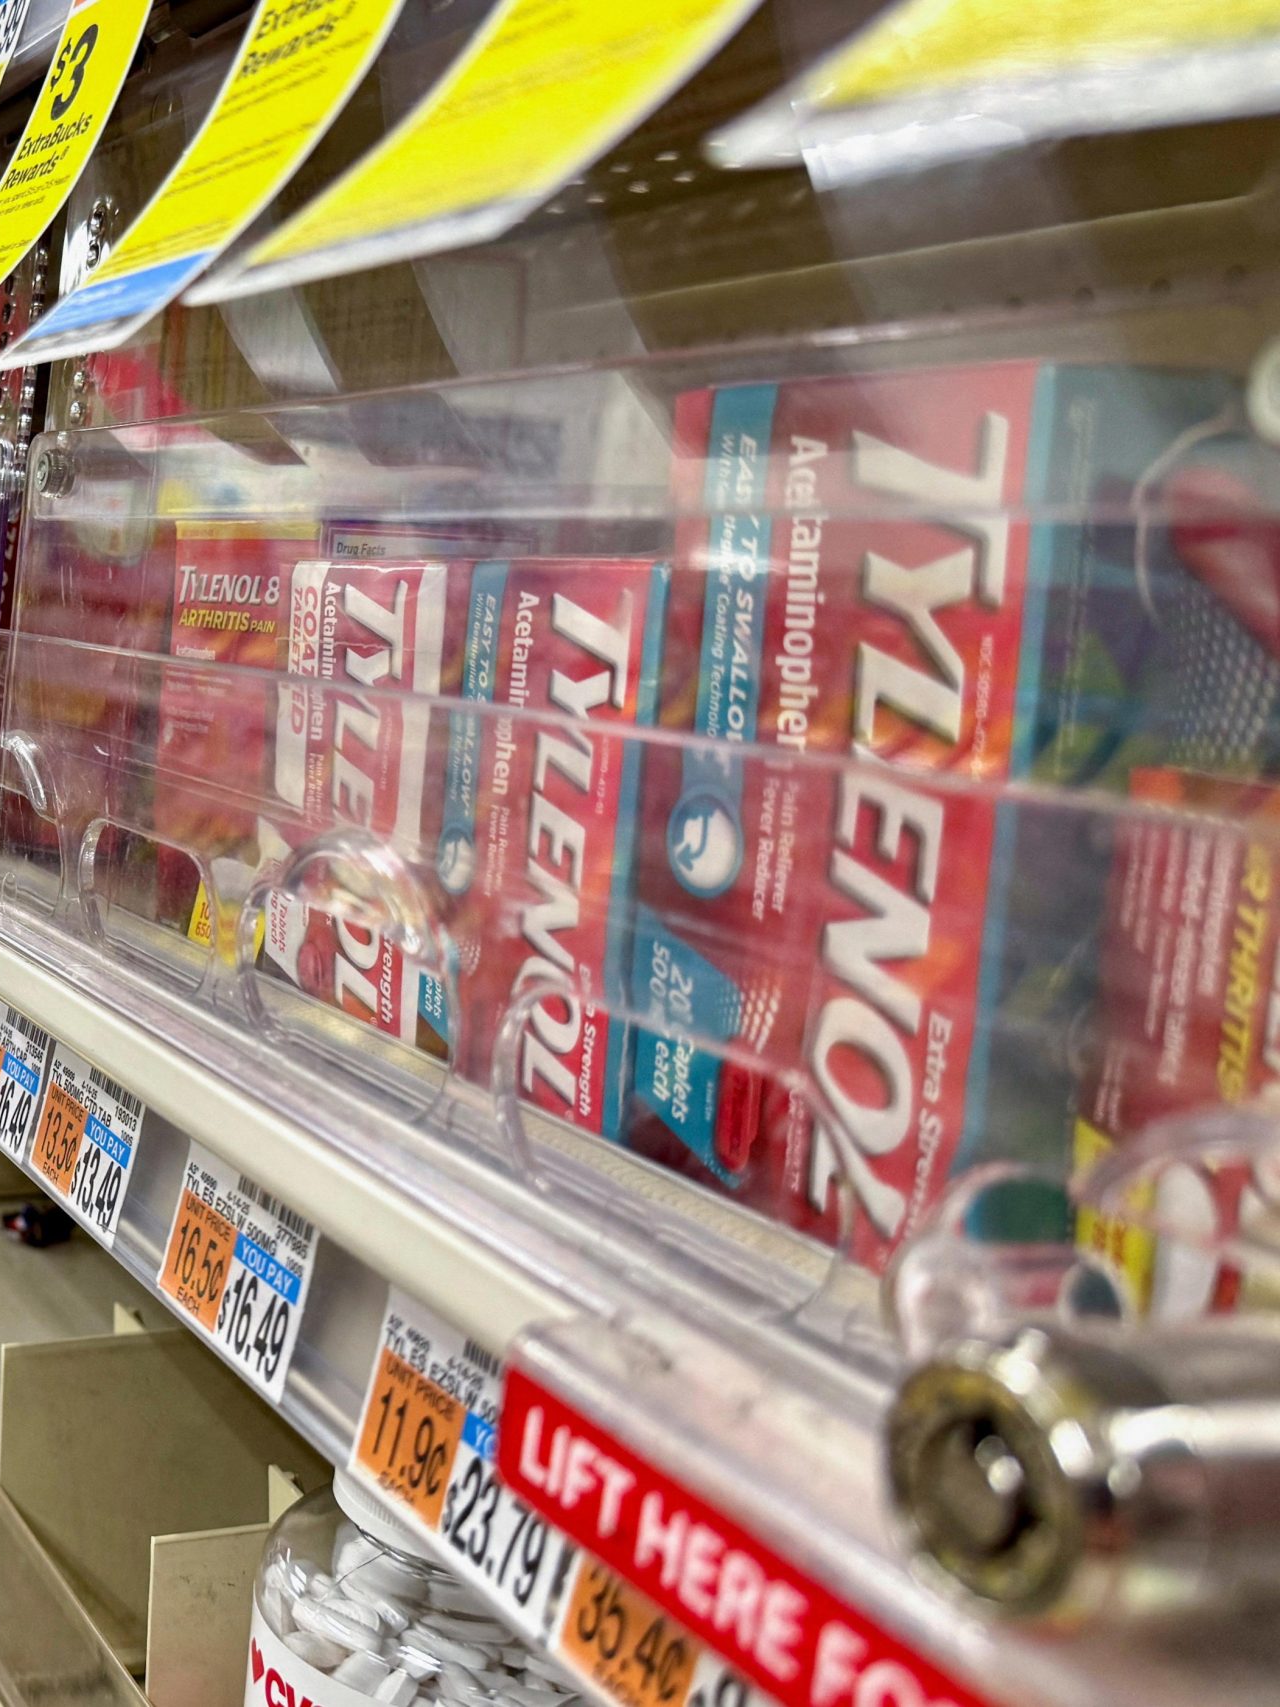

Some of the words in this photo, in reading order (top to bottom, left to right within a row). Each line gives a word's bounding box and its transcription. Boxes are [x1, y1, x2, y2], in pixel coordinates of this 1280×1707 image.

[51, 23, 99, 121] $3
[16, 112, 92, 161] ExtraBucks
[179, 566, 262, 604] TYLENOL
[264, 575, 281, 605] 8
[179, 609, 251, 632] ARTHRITIS
[250, 620, 276, 634] PAIN
[332, 579, 409, 1014] TYLEOL
[809, 411, 1009, 1239] TYLENOL
[515, 588, 633, 1107] TYLENOL
[378, 932, 395, 1025] trength
[6, 1056, 21, 1079] YOU
[19, 1066, 36, 1092] PAY
[51, 1067, 63, 1088] TYL
[83, 1096, 99, 1116] CTD
[98, 1105, 112, 1127] TAB
[579, 1021, 598, 1117] Strength
[651, 1039, 670, 1103] each
[924, 1012, 953, 1105] Extra
[40, 1105, 78, 1175] 13.5¢
[51, 1087, 67, 1108] UNIT
[66, 1097, 86, 1123] PRICE
[88, 1119, 107, 1147] YOU
[106, 1133, 127, 1161] PAY
[114, 1104, 138, 1132] 193013
[42, 1161, 60, 1184] EACH
[70, 1141, 122, 1234] $13.49
[185, 1172, 202, 1198] TYL
[201, 1187, 216, 1208] ES
[215, 1196, 247, 1233] EZSLW
[246, 1219, 278, 1258] 500MG
[185, 1194, 207, 1222] UNIT
[206, 1210, 232, 1243] PRICE
[173, 1218, 224, 1305] 16.5¢
[175, 1285, 201, 1316] EACH
[240, 1240, 269, 1276] YOU
[267, 1261, 295, 1296] PAY
[217, 1268, 289, 1384] $16.49
[371, 1385, 449, 1496] 11.9¢
[441, 1455, 549, 1608] $23.79
[519, 1403, 637, 1538] LIFT
[632, 1490, 810, 1684] HERE
